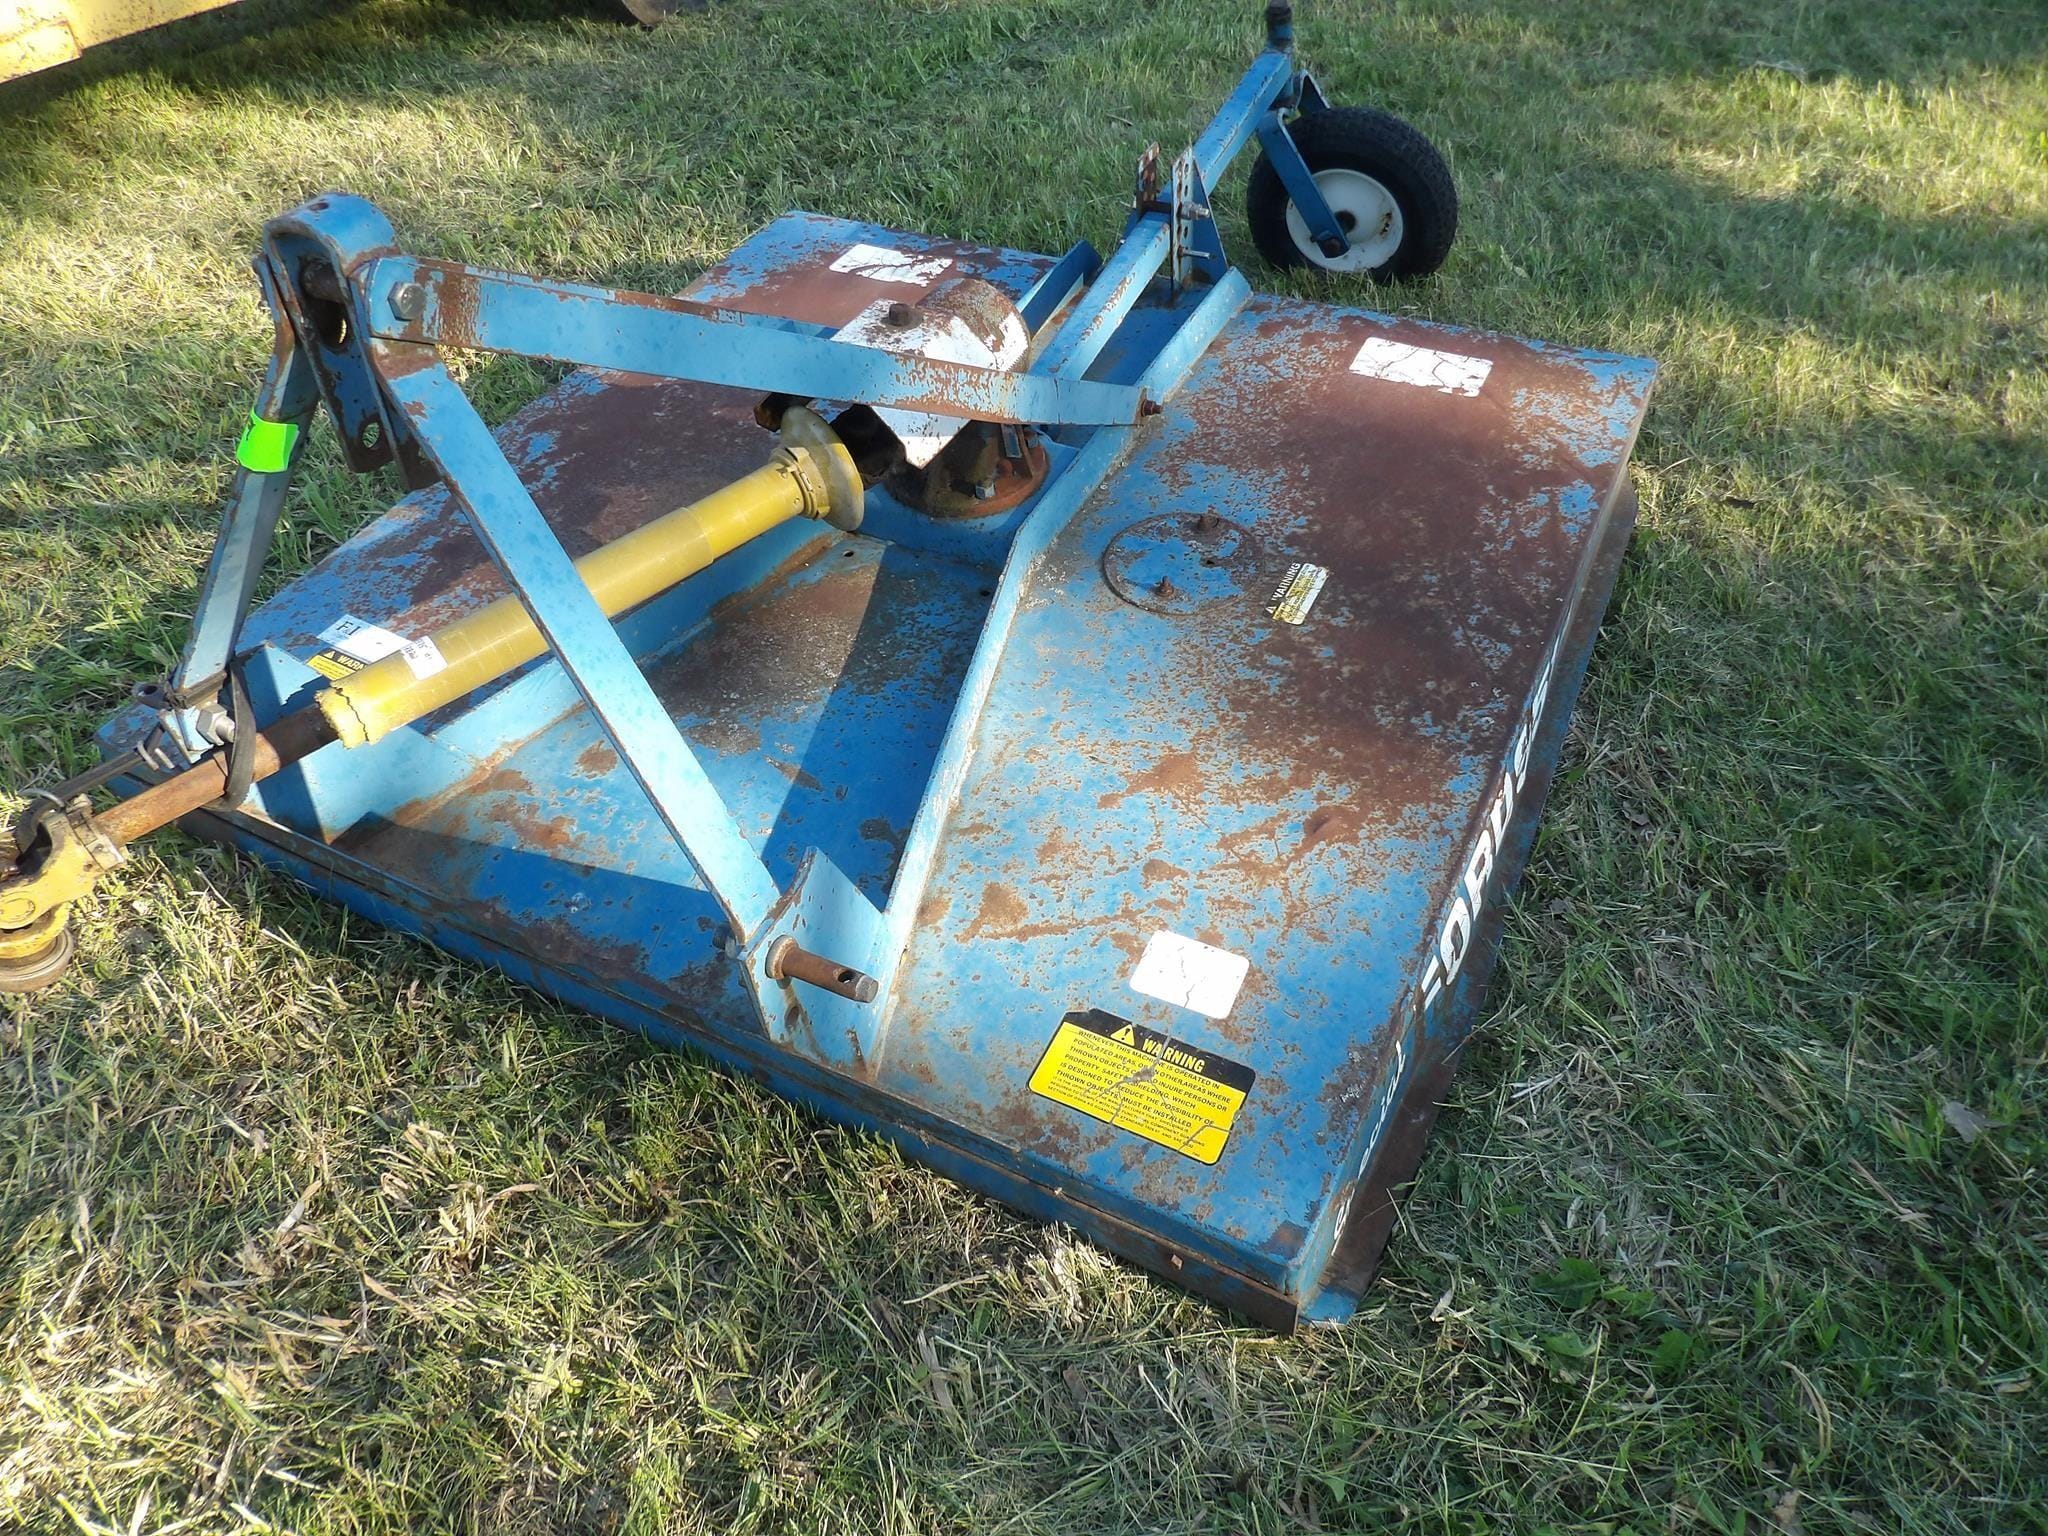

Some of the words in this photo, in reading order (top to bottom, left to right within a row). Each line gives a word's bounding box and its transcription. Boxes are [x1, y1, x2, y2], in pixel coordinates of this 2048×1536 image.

[337, 655, 367, 671] WARN
[1069, 1045, 1098, 1061] THROWN
[1098, 1057, 1130, 1073] OBJECTS
[1158, 1081, 1183, 1094] INJURE
[1184, 1091, 1216, 1107] PERSONS
[1216, 1104, 1227, 1112] OR
[1073, 1037, 1114, 1057] POPULATED
[1181, 1080, 1206, 1094] AREAS
[1206, 1090, 1230, 1103] WHERE
[1077, 1030, 1114, 1048] WHENEVER
[1116, 1044, 1131, 1054] THIS
[1174, 1068, 1211, 1086] OPERATED
[1140, 1038, 1206, 1073] WARNING
[1056, 1069, 1085, 1084] THROWN
[1121, 1096, 1142, 1108] MUST
[1067, 1064, 1102, 1082] DESIGNED
[1115, 1084, 1144, 1099] REDUCE
[1145, 1096, 1159, 1105] THE
[1160, 1102, 1202, 1122] POSSIBILITY
[1203, 1118, 1214, 1126] OF
[1171, 1096, 1196, 1109] WHICH
